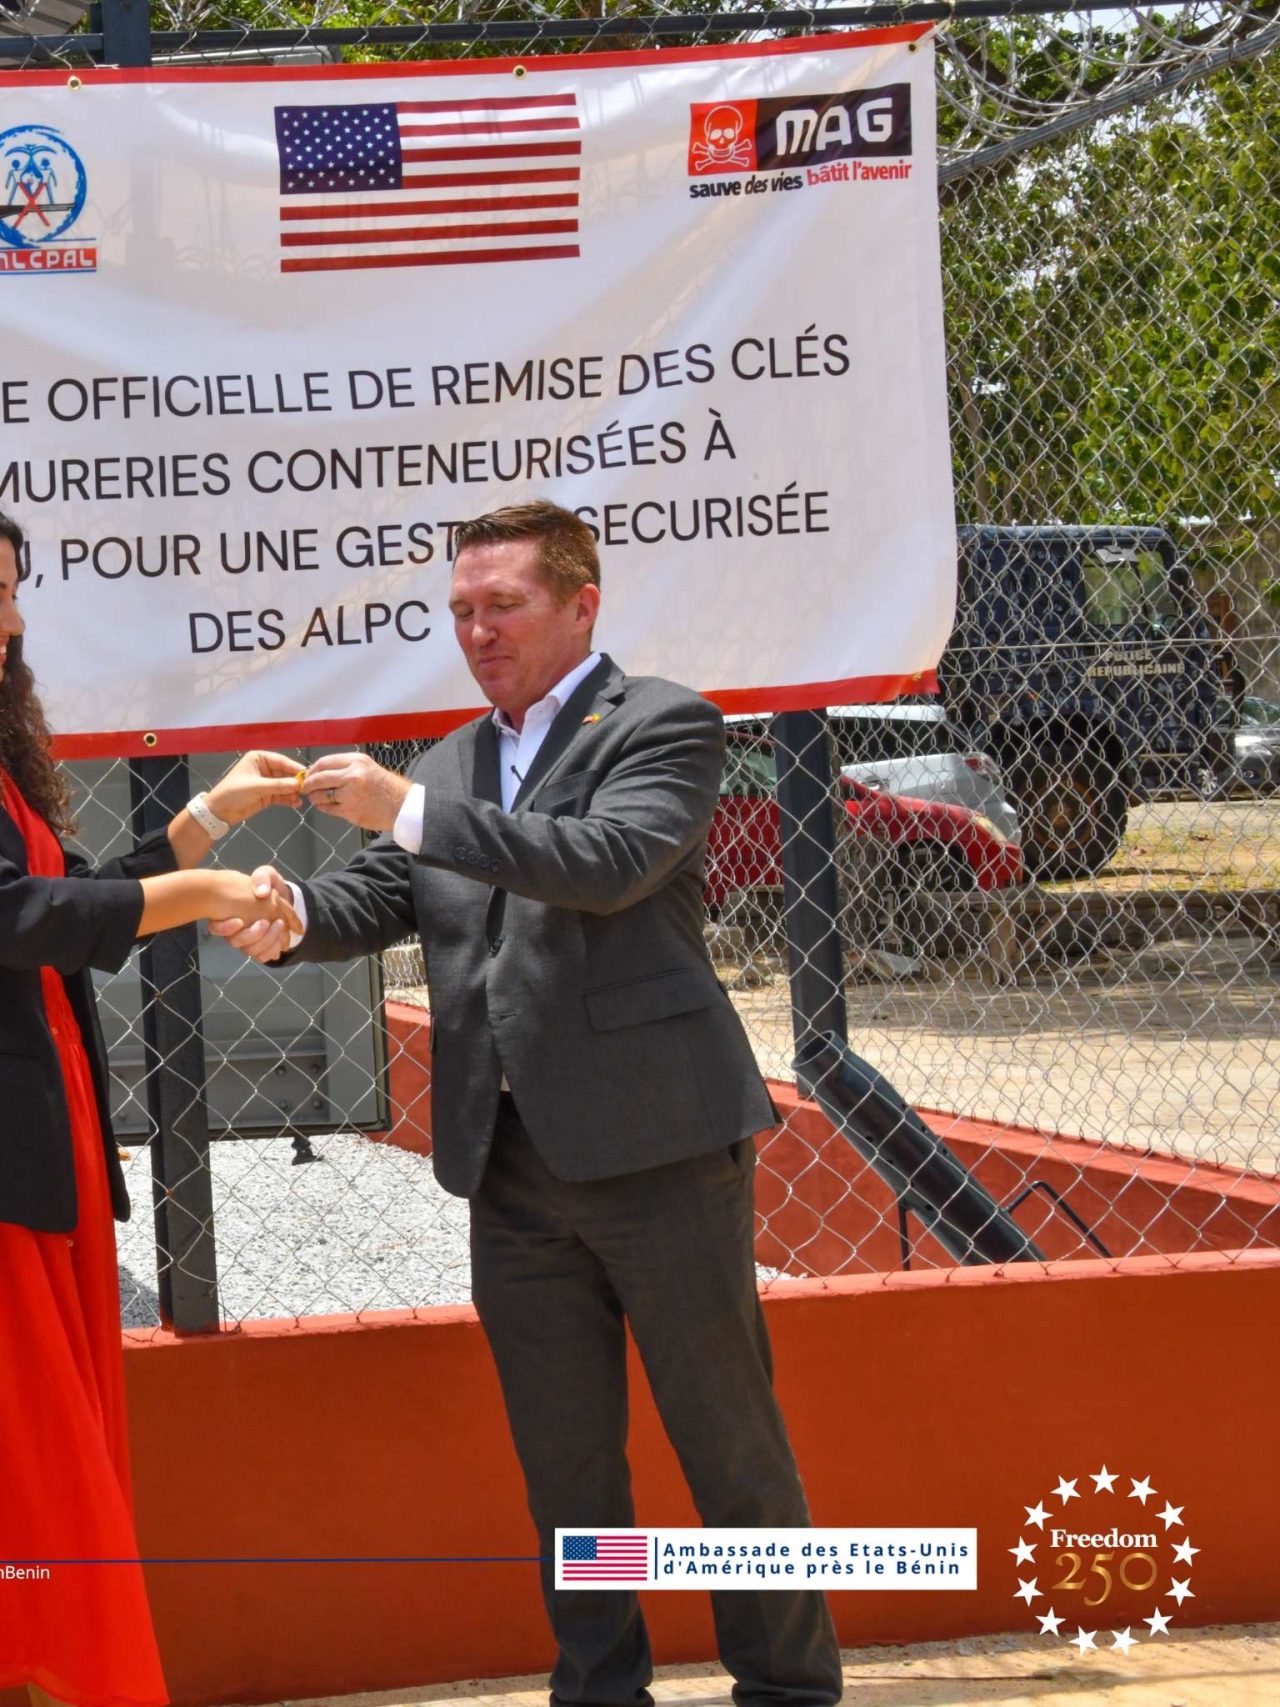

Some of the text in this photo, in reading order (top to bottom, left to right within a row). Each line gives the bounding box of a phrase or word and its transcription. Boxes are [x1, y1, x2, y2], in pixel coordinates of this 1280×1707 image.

[776, 97, 893, 156] MAG
[689, 159, 912, 198] sauve des vies bâtit l'avenir
[48, 370, 332, 421] OFFICIELLE
[349, 367, 415, 409] DE
[431, 357, 603, 405] REMISE
[618, 343, 714, 395] DES
[731, 324, 850, 381] CLÉS
[248, 420, 687, 493] CONTENEURISÉES
[703, 408, 737, 460] À
[61, 529, 201, 581] POUR
[221, 522, 320, 573] UNE
[337, 521, 464, 568] GEST
[190, 600, 431, 654] DES ALPC
[1104, 648, 1153, 661] POLICE
